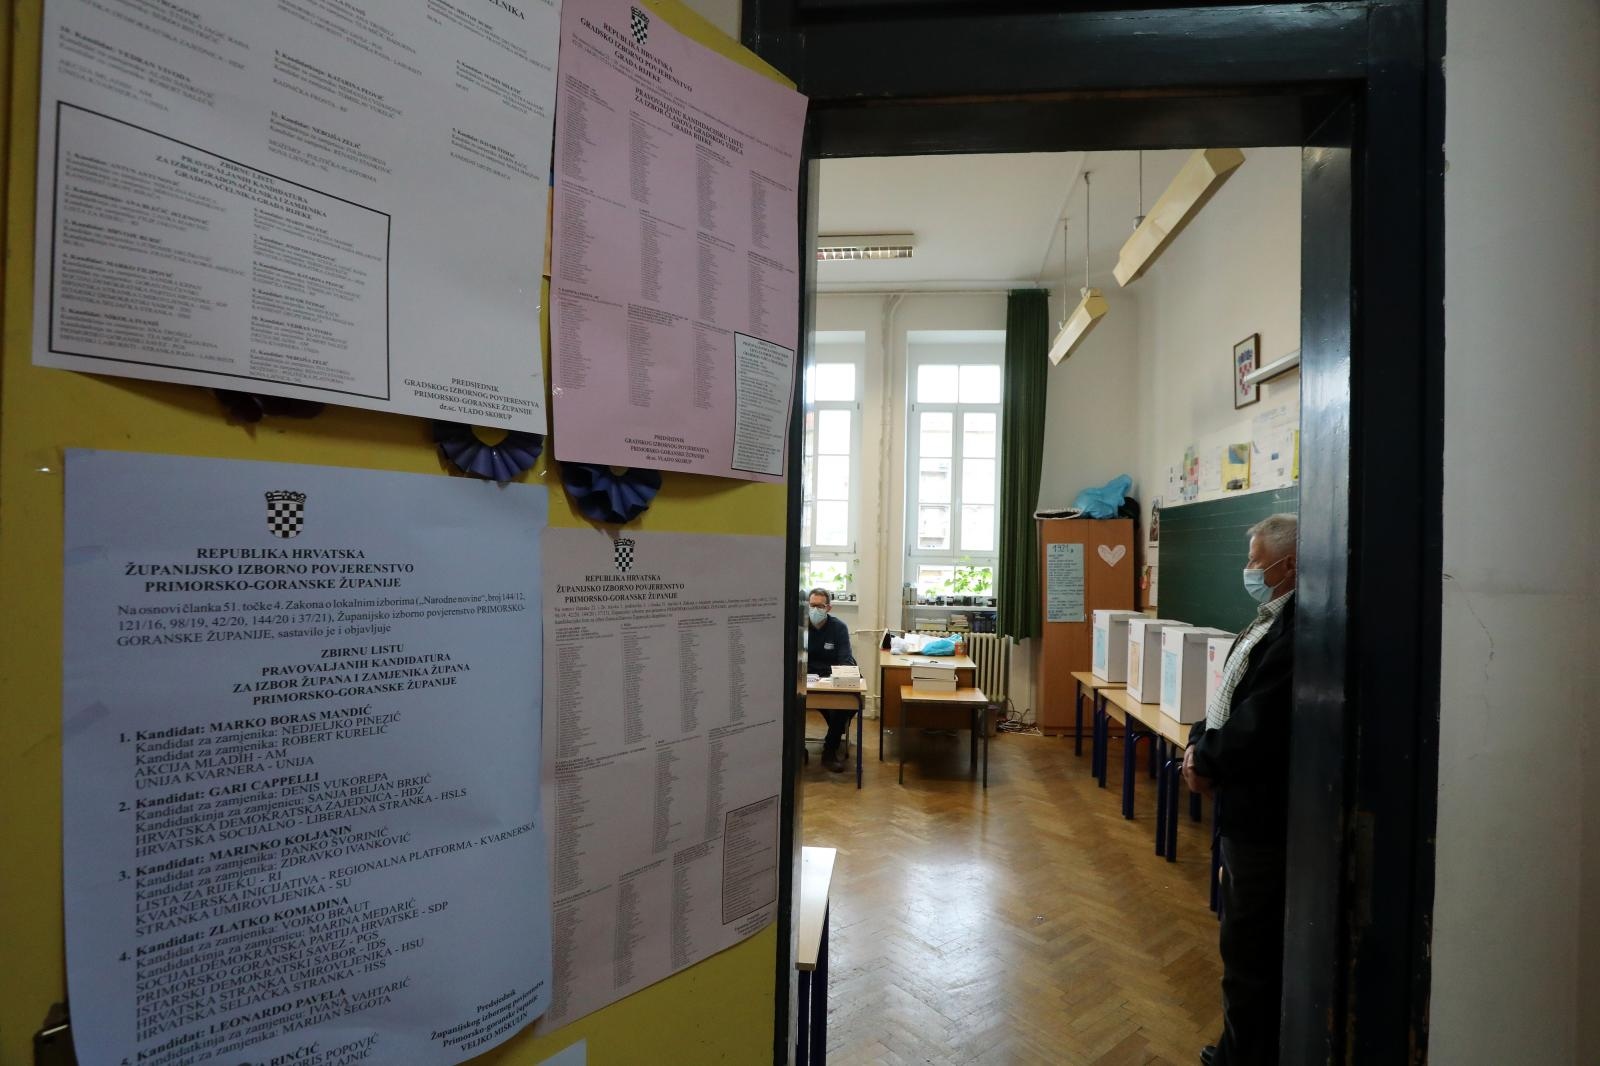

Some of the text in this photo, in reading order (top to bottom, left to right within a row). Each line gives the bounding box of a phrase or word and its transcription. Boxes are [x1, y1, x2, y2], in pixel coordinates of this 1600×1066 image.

[125, 562, 414, 575] ŽUPANIJSKO IZBORNO POVJERENSTVO
[197, 548, 364, 559] REPUBLIKA HRVATSKA
[145, 576, 401, 592] PRIMORSKO-GORANSKE ŽUPANIJE
[585, 574, 660, 582] REPUBLIKA HRVATSKA
[116, 632, 203, 646] GORANSKE
[206, 628, 274, 642] ŽUPANIJE,
[278, 626, 322, 638] sastavilo
[323, 626, 336, 638] je
[344, 623, 392, 636] objavljuje
[262, 653, 450, 676] PRAVOVALJANIH KANDIDATURA
[320, 643, 403, 658] ZBIRNU LISTU
[233, 681, 251, 693] ZA
[255, 677, 297, 691] IZBOR
[301, 673, 351, 686] ŽUPANA
[361, 666, 428, 681] ZAMJENIKA
[431, 663, 470, 674] ŽUPANA
[253, 677, 456, 705] PRIMORSKO-GORANSKE ŽUPANIJE
[120, 704, 371, 743] 1. Kandidat: MARKO BORAS MANDIĆ
[135, 711, 401, 753] Kandidat za zamjenika: NEDJELJKO PINEZIĆ
[134, 761, 190, 778] AKCIJA
[194, 753, 254, 770] MLADIH
[265, 748, 287, 760] AM
[135, 748, 194, 765] Kandidat
[197, 749, 211, 757] za
[214, 739, 278, 755] zamjenika:
[281, 731, 332, 747] ROBERT
[135, 774, 181, 790] UNIJA
[185, 763, 264, 783] KVARNERA
[276, 757, 314, 771] UNIJA
[118, 771, 318, 812] 2. Kandidat: GARI CAPPELLI
[135, 772, 388, 821] Kandidat za zamjenika: DENIS VUKOREPA
[135, 810, 224, 834] Kandidatkinja
[227, 809, 242, 818] za
[307, 788, 347, 803] SANJA
[350, 781, 394, 796] BELJAN
[397, 773, 432, 787] BRKIĆ
[118, 825, 352, 882] 3. Kandidat: MARINKO KOLJANIN
[135, 867, 193, 889] Kandidat
[197, 866, 211, 876] za
[215, 852, 277, 872] zamjenika:
[280, 840, 328, 859] DANKO
[136, 933, 204, 958] Kandidat:
[209, 916, 270, 940] ZLATKO
[273, 897, 348, 924] KOMADINA
